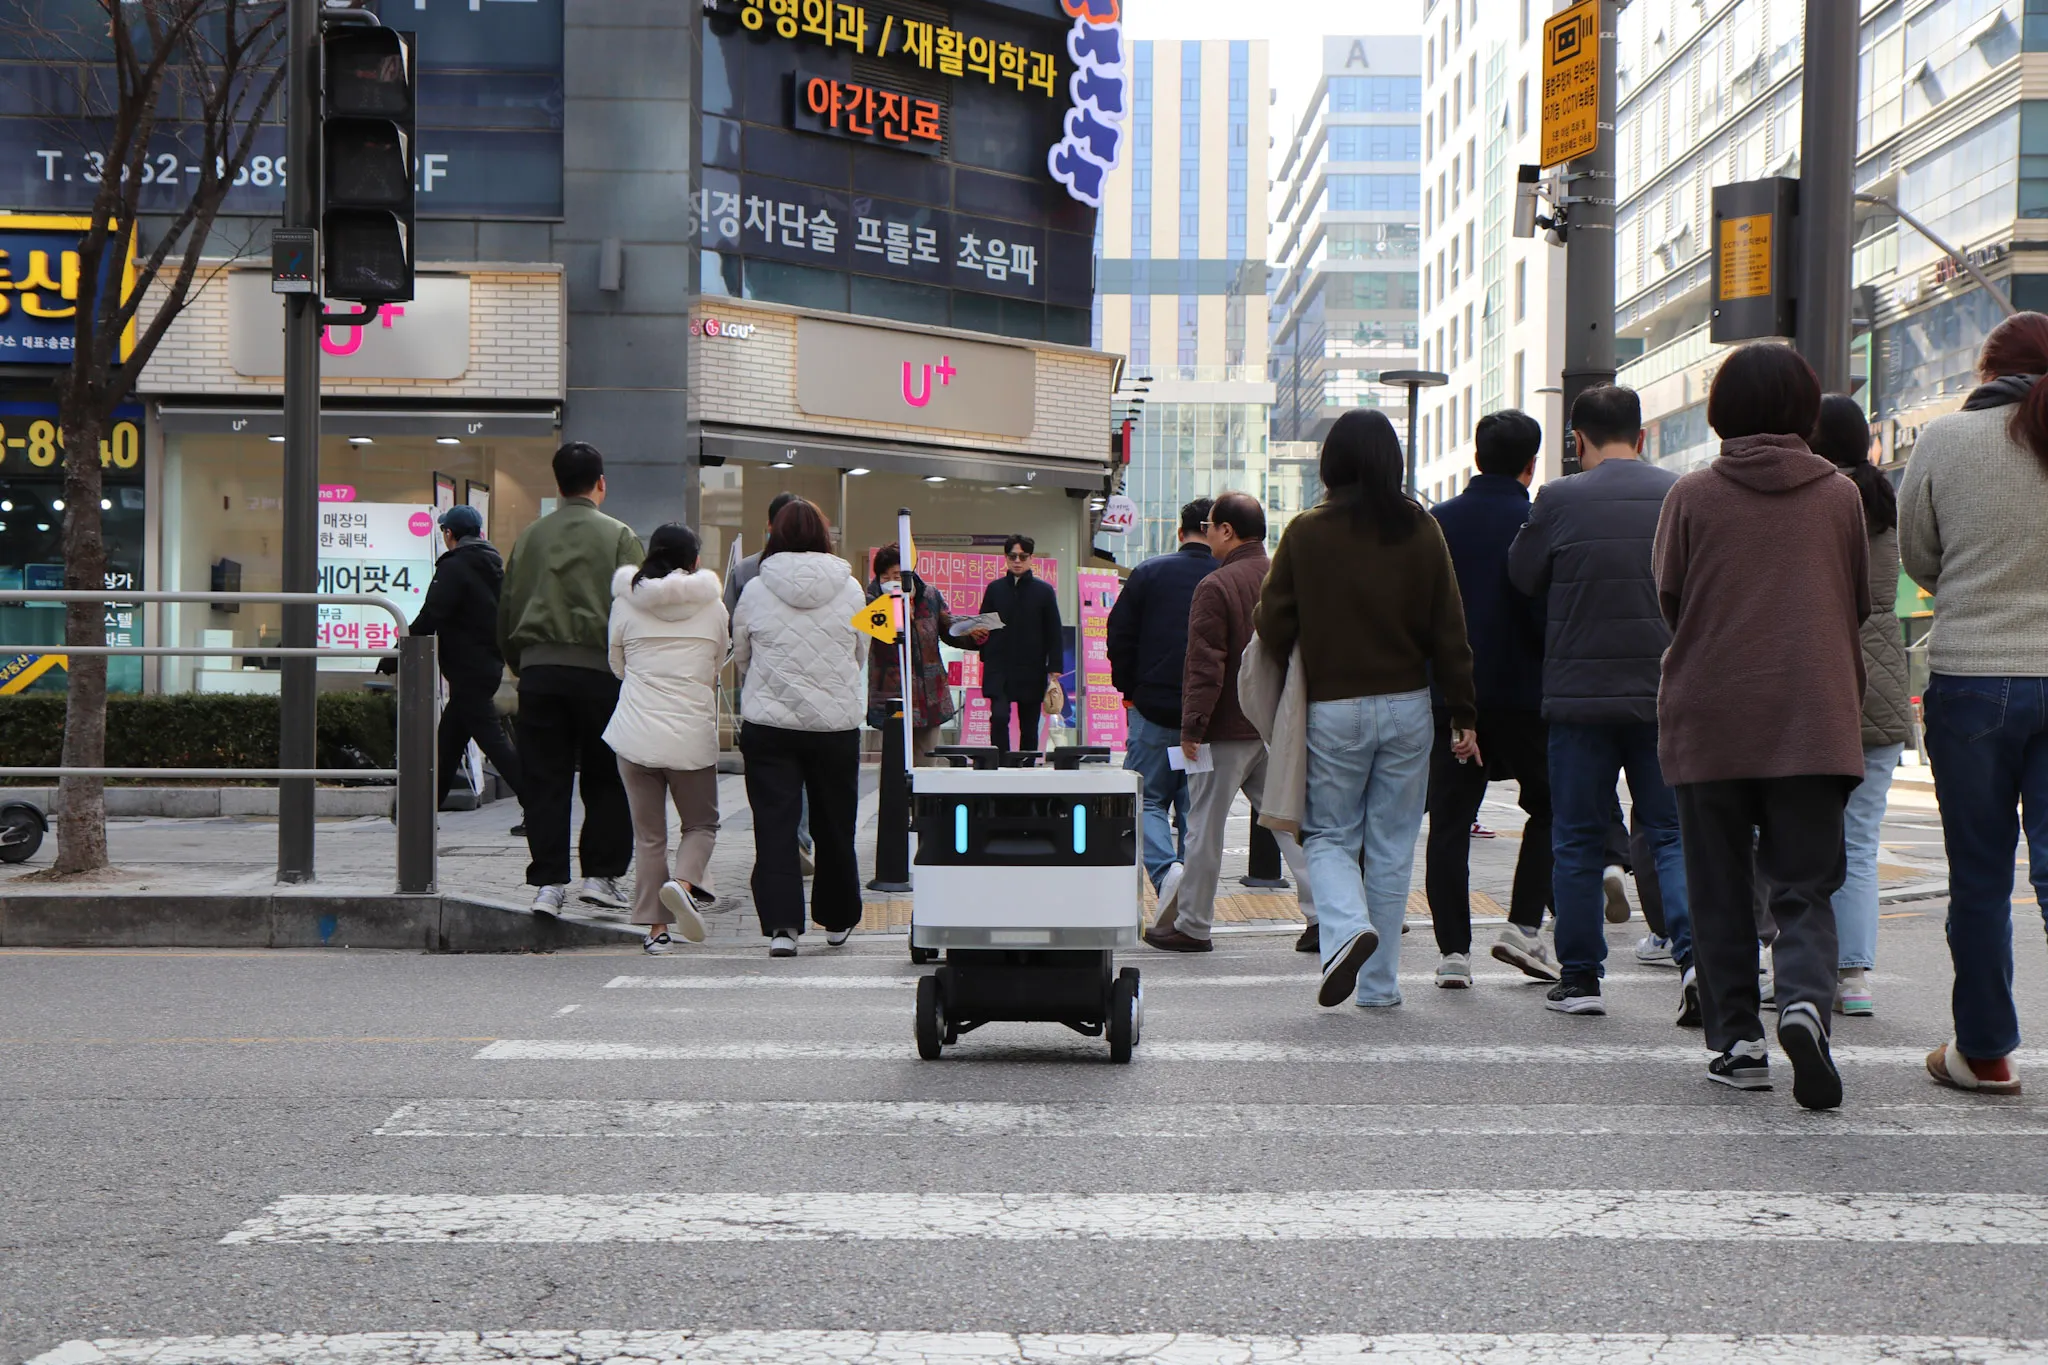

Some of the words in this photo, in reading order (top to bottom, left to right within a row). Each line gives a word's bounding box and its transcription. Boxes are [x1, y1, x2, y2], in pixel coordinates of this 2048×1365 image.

[902, 18, 1057, 97] 재활의학과
[1344, 39, 1369, 68] A
[807, 77, 942, 142] 야간진료
[415, 154, 448, 192] F
[855, 217, 940, 266] 프롤로
[956, 233, 1038, 286] 초음파
[0, 249, 80, 318] 산
[335, 489, 348, 499] 17
[323, 513, 367, 529] 매장의
[364, 622, 399, 649] 할
